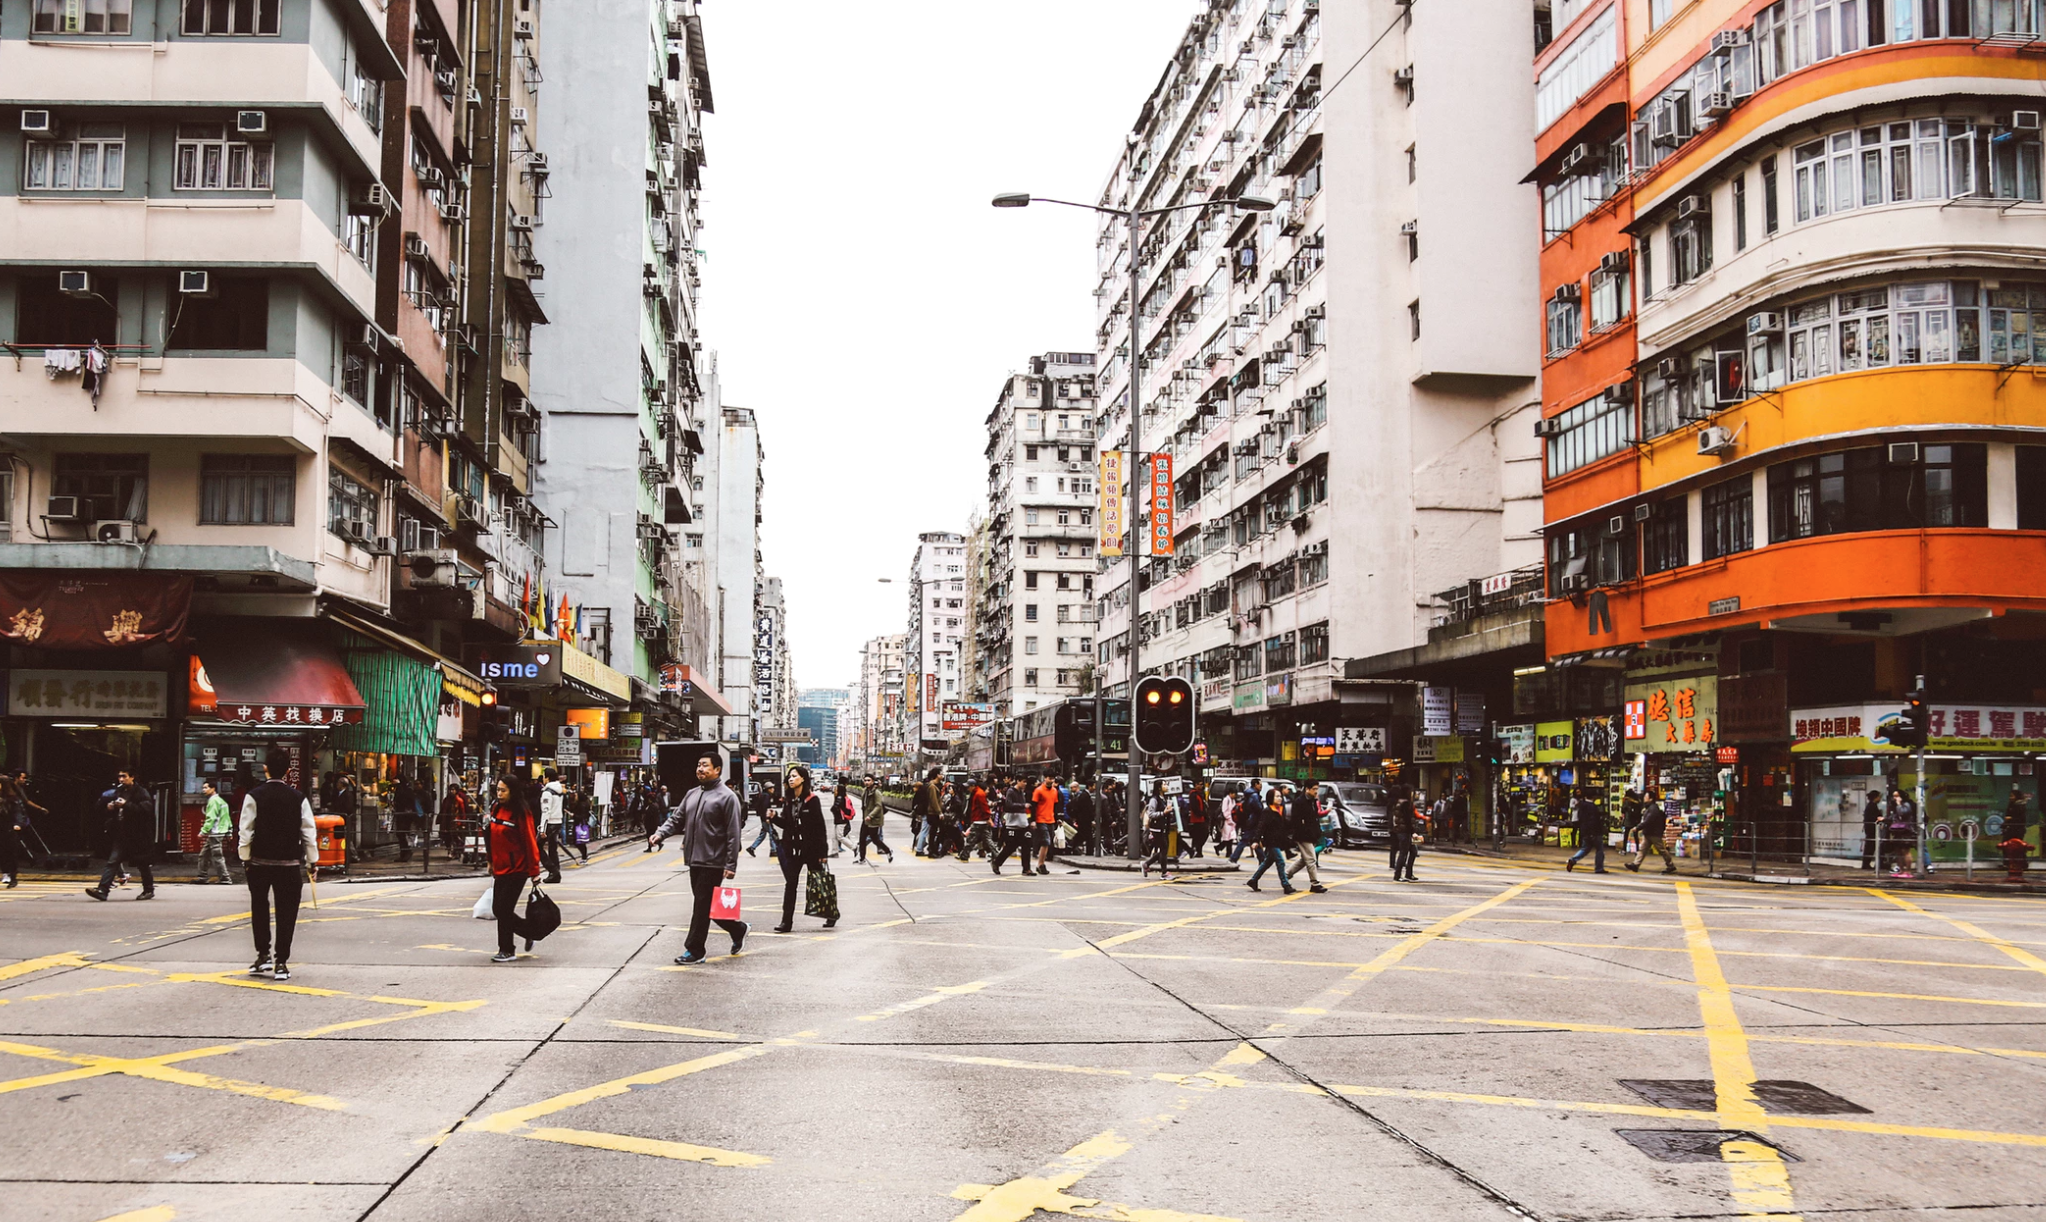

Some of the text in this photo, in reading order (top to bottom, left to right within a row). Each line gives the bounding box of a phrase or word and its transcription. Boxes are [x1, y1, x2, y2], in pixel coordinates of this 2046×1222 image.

[481, 661, 539, 678] isme
[201, 705, 212, 713] TEL
[1647, 687, 1696, 722] 德信
[237, 705, 345, 723] 中英找換店
[1665, 718, 1715, 744] 大藥房
[1795, 716, 1861, 739] 換領中國牌
[1110, 739, 1121, 750] 41
